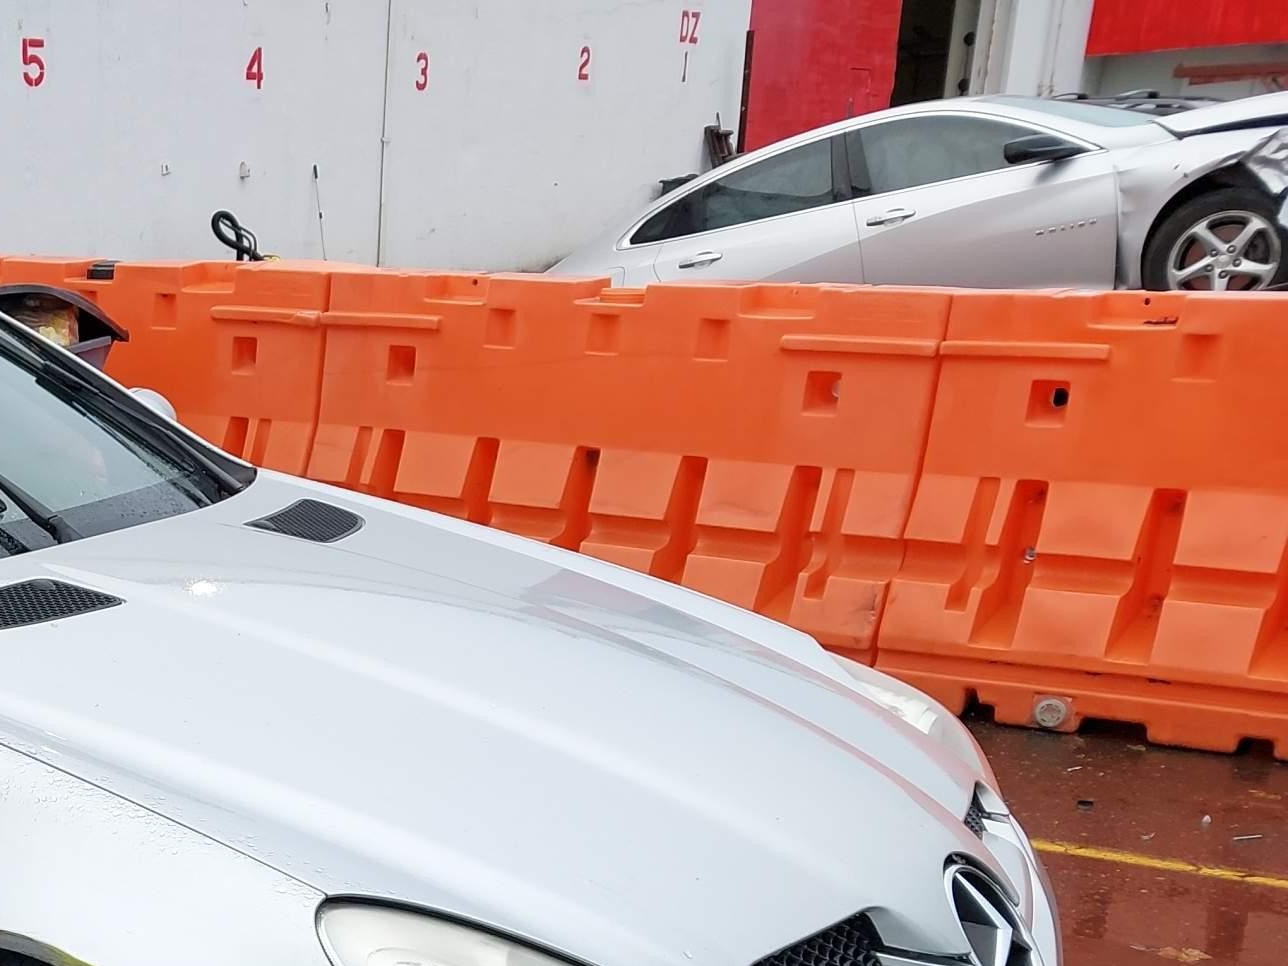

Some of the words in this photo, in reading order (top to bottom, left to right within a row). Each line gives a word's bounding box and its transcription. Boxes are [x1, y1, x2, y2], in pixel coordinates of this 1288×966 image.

[22, 38, 45, 88] 5
[245, 46, 264, 90] 4
[415, 52, 429, 91] 3
[578, 45, 591, 81] 2
